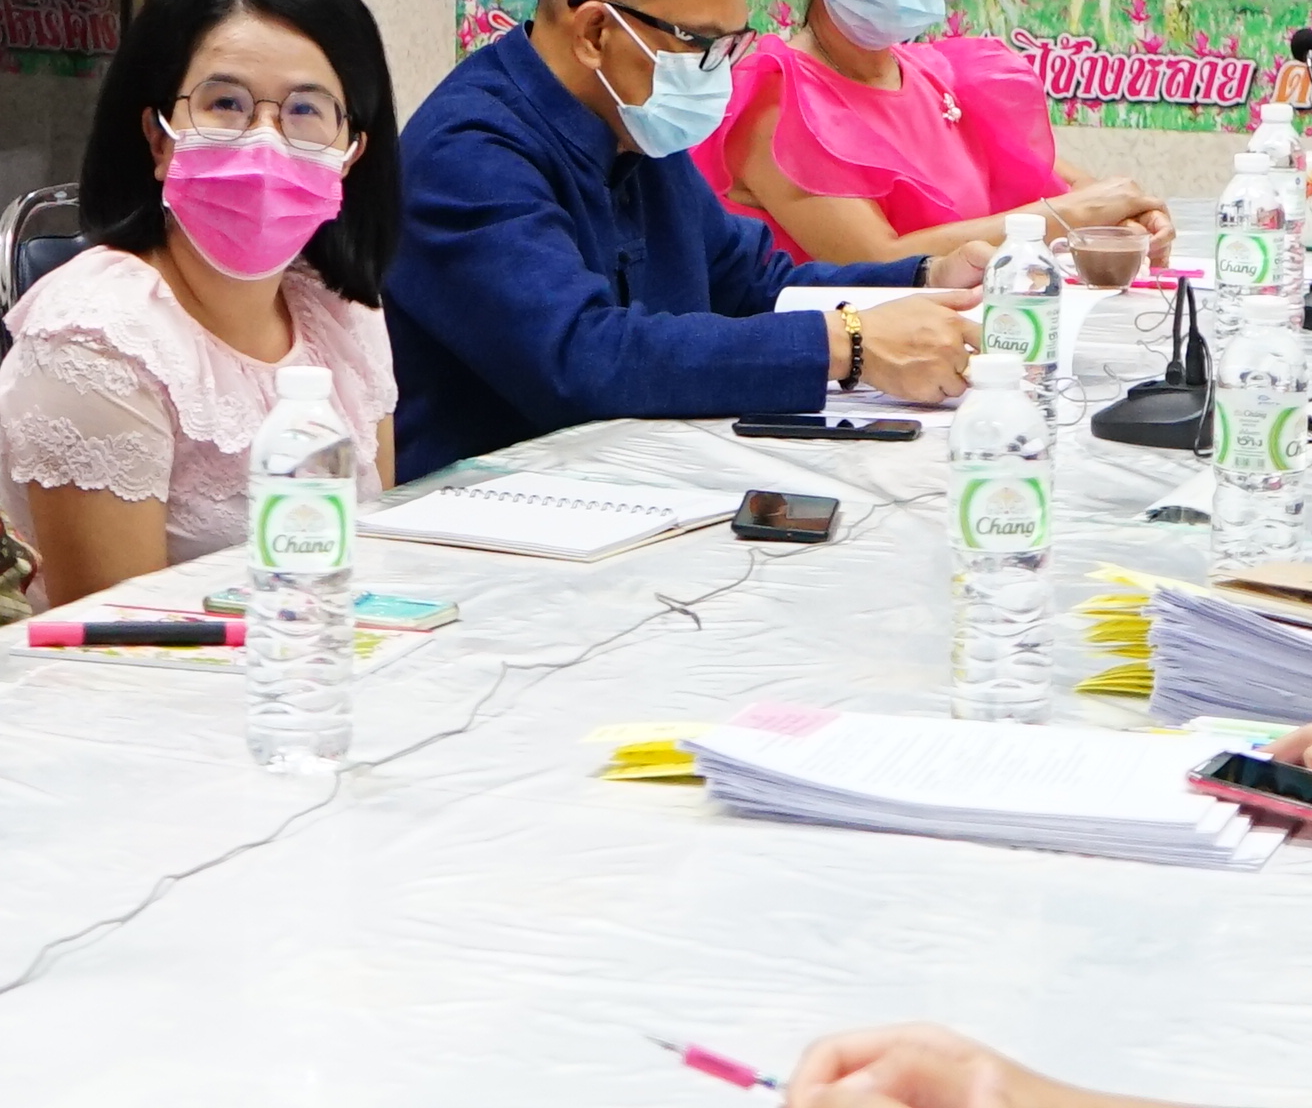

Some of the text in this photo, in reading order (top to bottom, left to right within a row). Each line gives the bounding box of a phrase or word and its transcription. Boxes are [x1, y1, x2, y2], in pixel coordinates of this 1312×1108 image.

[1219, 259, 1258, 278] Chang
[987, 333, 1029, 354] Chang
[976, 516, 1035, 537] Chang
